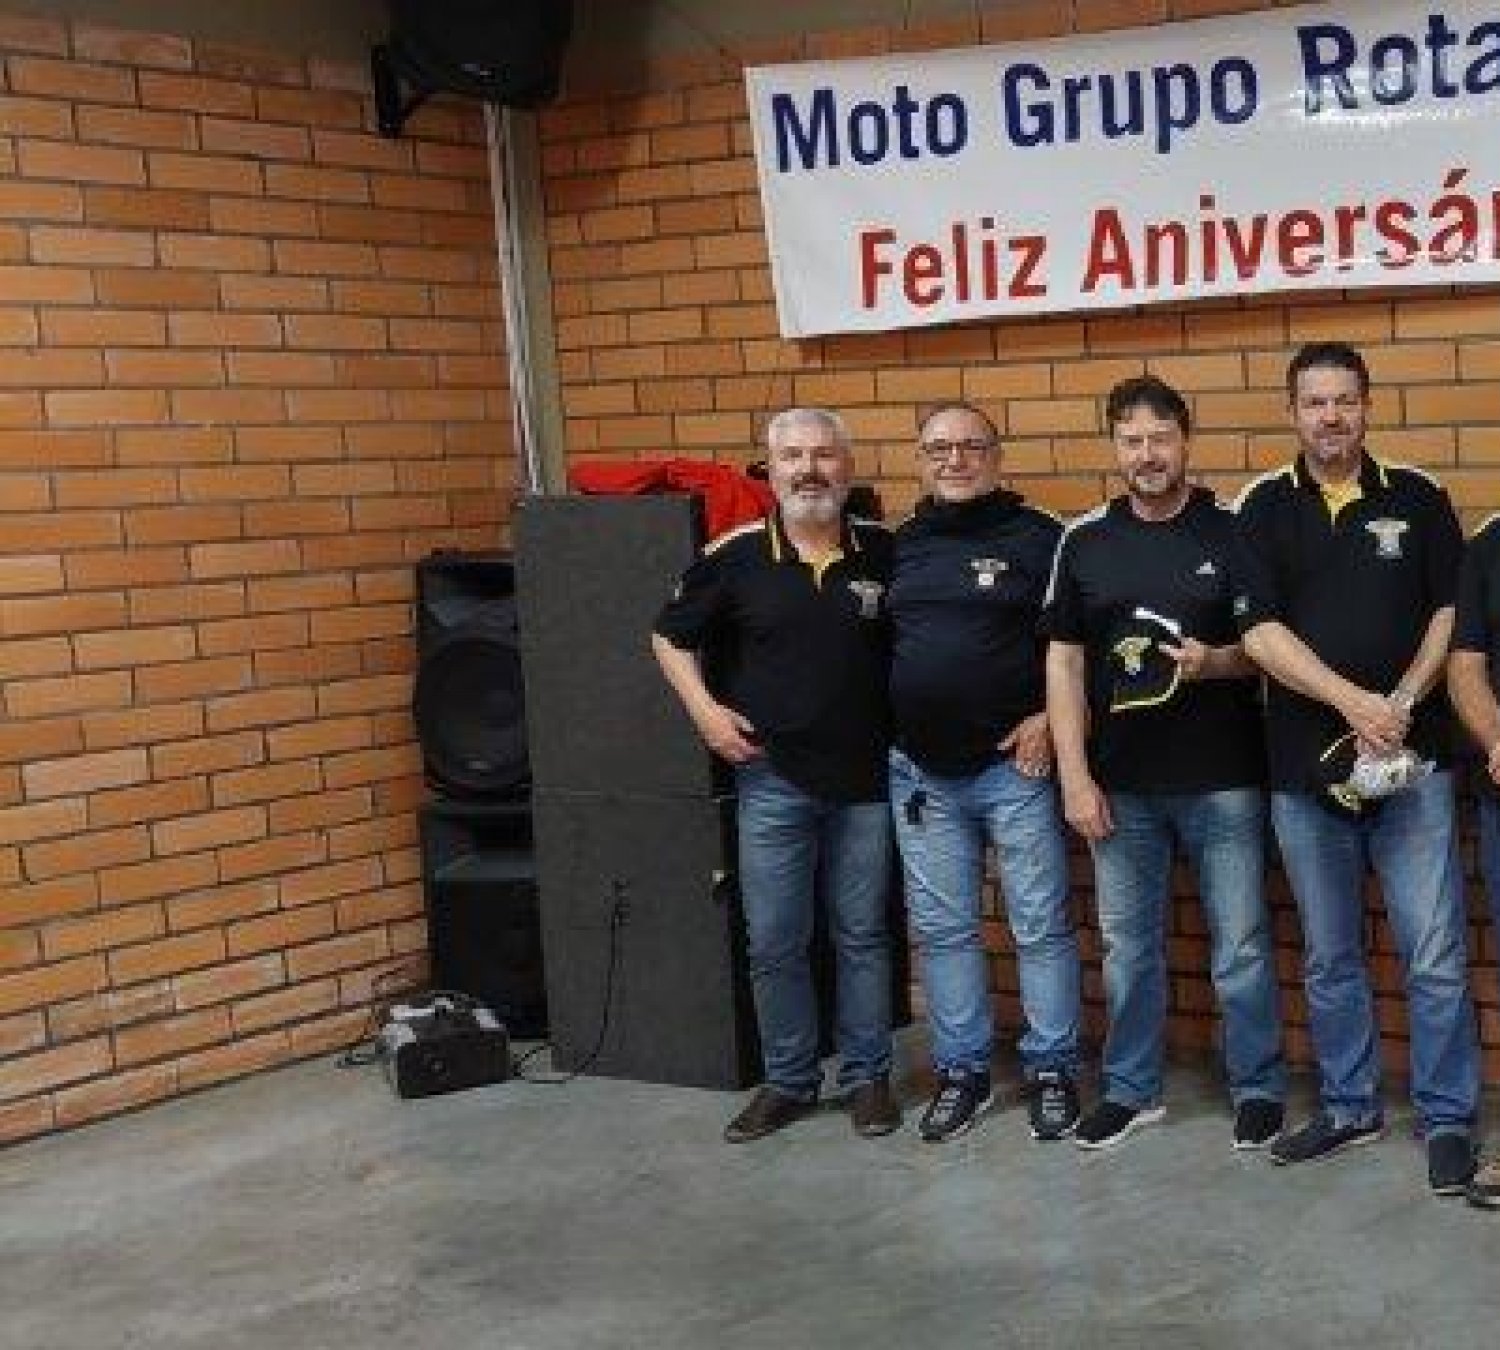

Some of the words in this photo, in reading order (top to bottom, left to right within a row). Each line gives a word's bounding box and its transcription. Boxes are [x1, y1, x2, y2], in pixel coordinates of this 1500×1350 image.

[771, 86, 968, 173] Moto
[1002, 57, 1258, 154] Grupo
[859, 216, 1047, 309] Feliz
